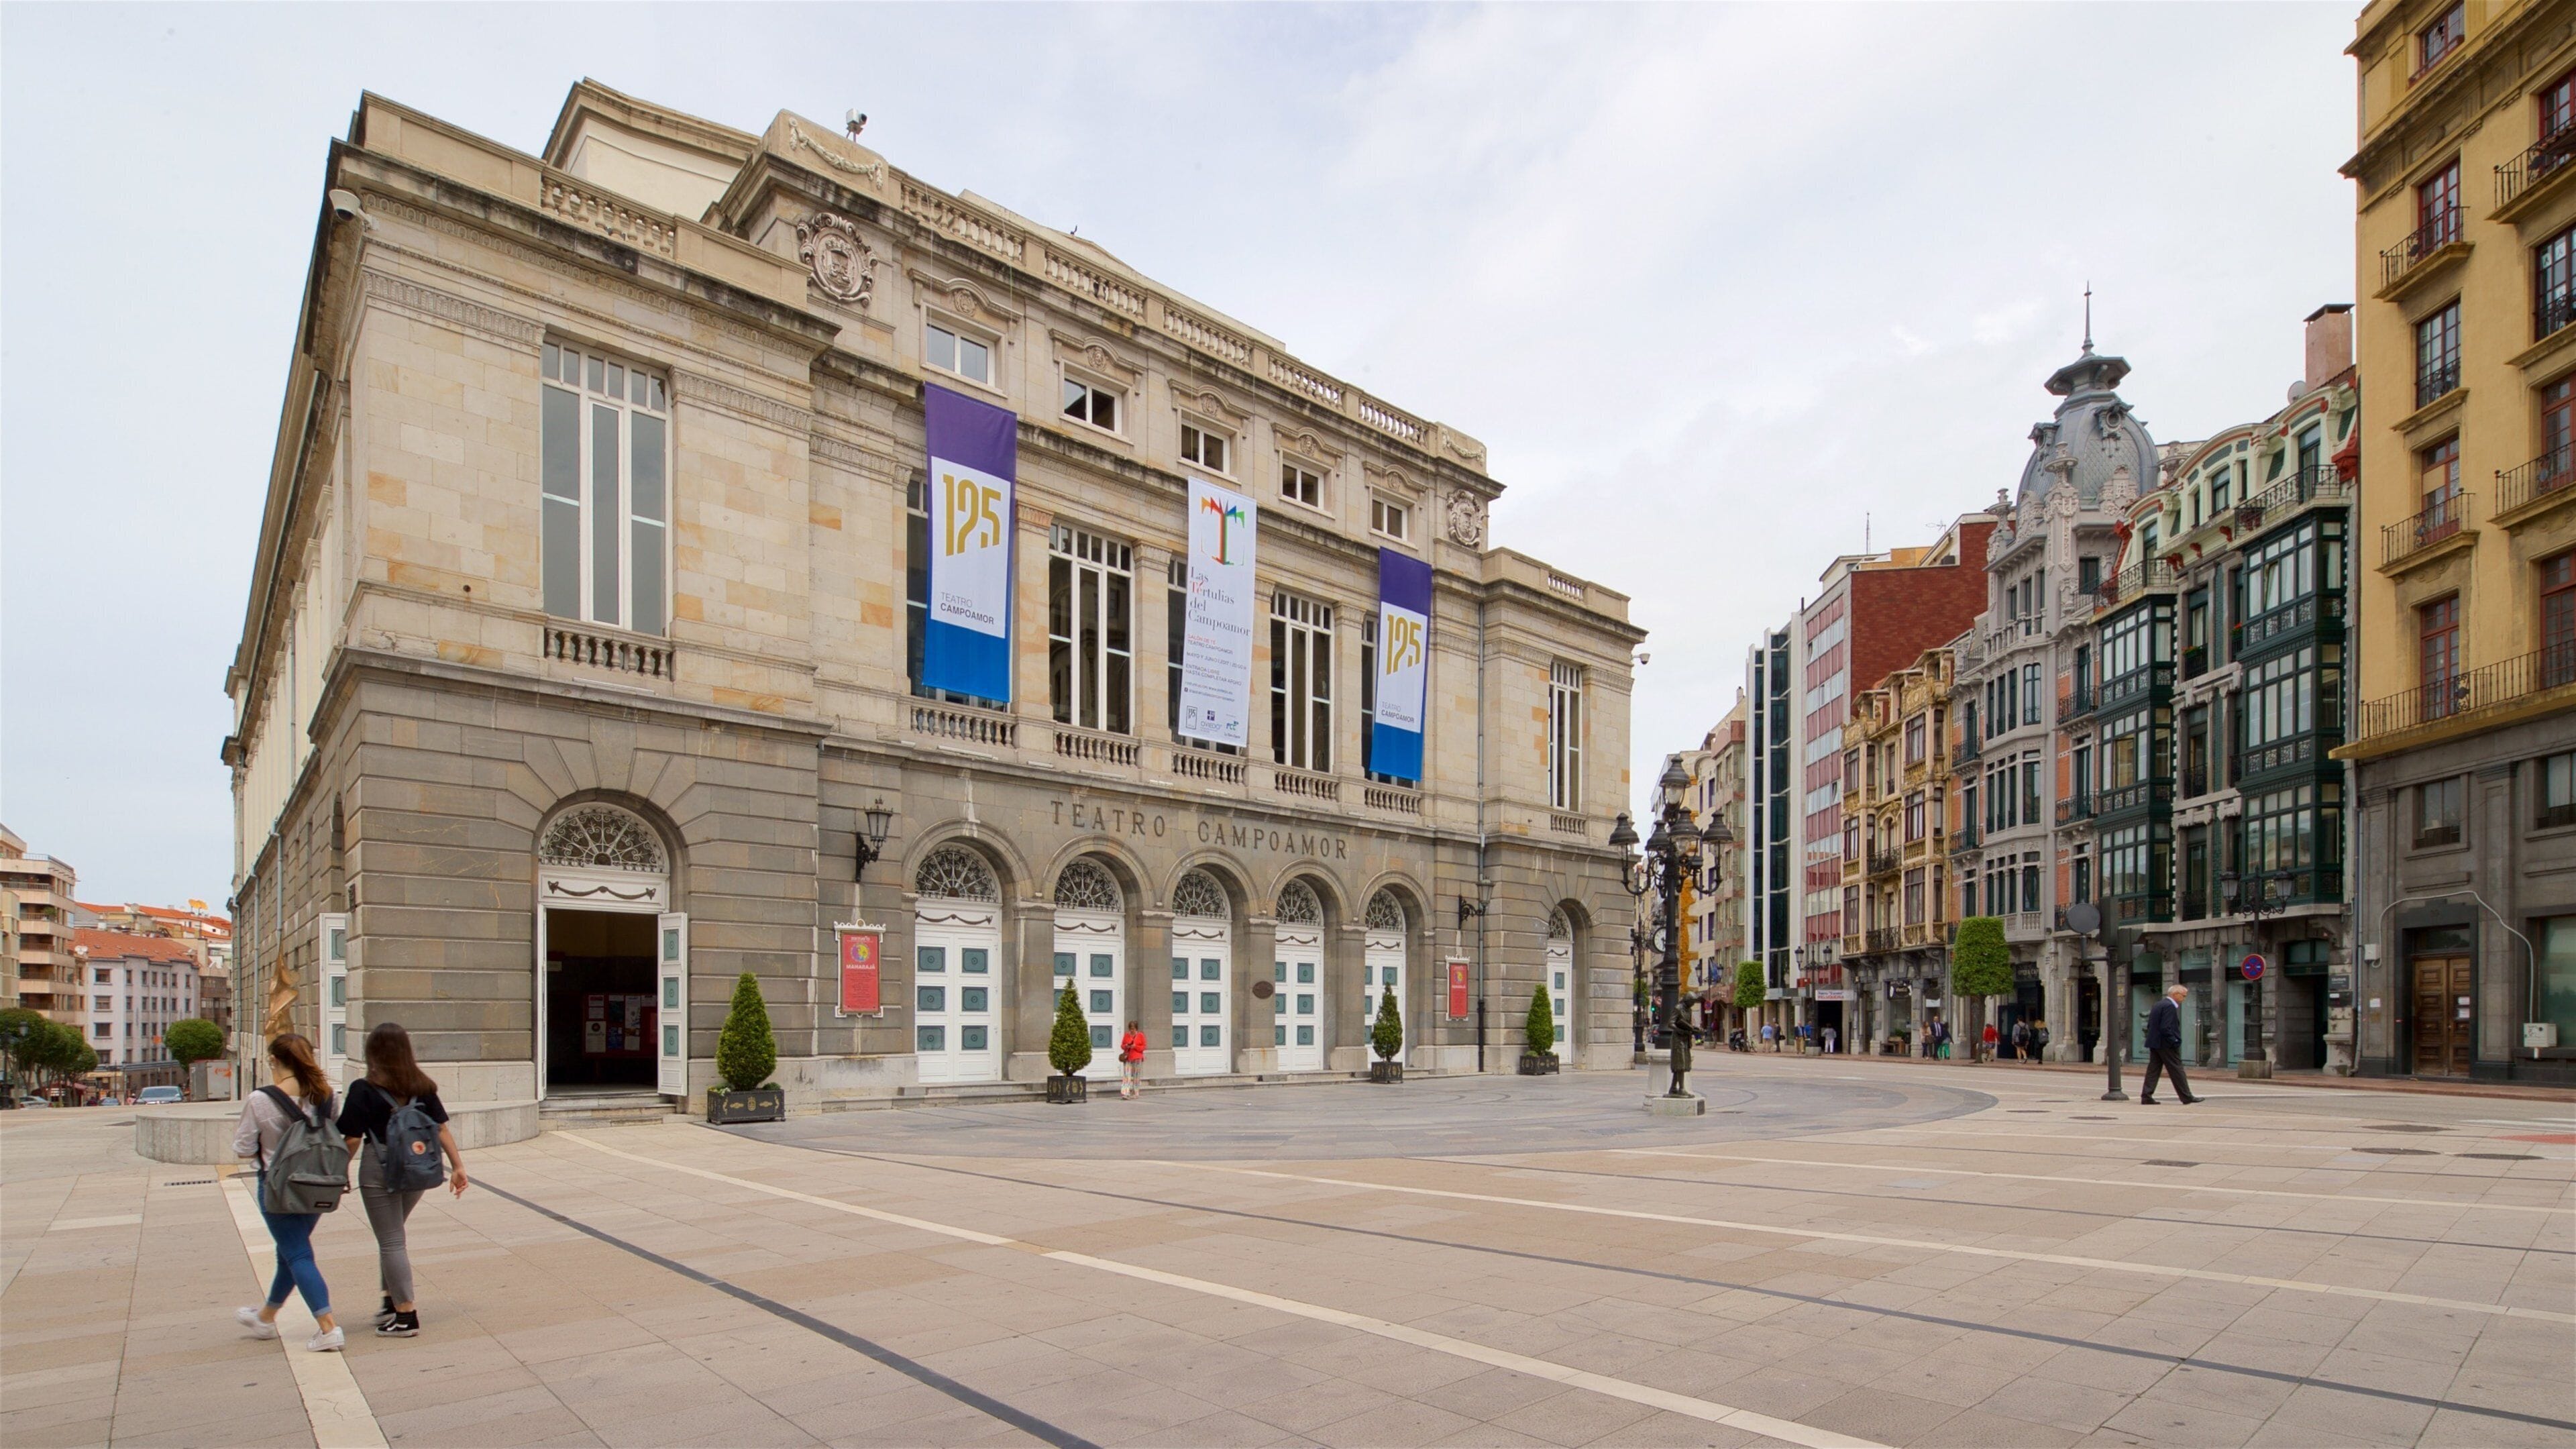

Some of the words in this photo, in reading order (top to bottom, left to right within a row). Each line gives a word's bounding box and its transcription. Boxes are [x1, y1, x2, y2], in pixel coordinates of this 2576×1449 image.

[943, 474, 1001, 556] 125
[1191, 566, 1209, 582] Las
[941, 592, 973, 608] TEATRO
[1189, 597, 1206, 611] del
[940, 603, 994, 625] CAMPOAMOR
[1188, 609, 1251, 636] Campoamor
[1187, 639, 1205, 647] TEATRO
[1205, 644, 1234, 655] CAMPOAMOR
[1387, 614, 1421, 675] 125
[1185, 663, 1208, 672] ENTRADA
[1201, 672, 1227, 682] COMPLETAR
[1381, 701, 1401, 712] TEATRO
[1381, 709, 1415, 724] CAMPOAMOR
[1051, 800, 1165, 837] TEATRO
[1197, 820, 1347, 859] CAMPOAMOR
